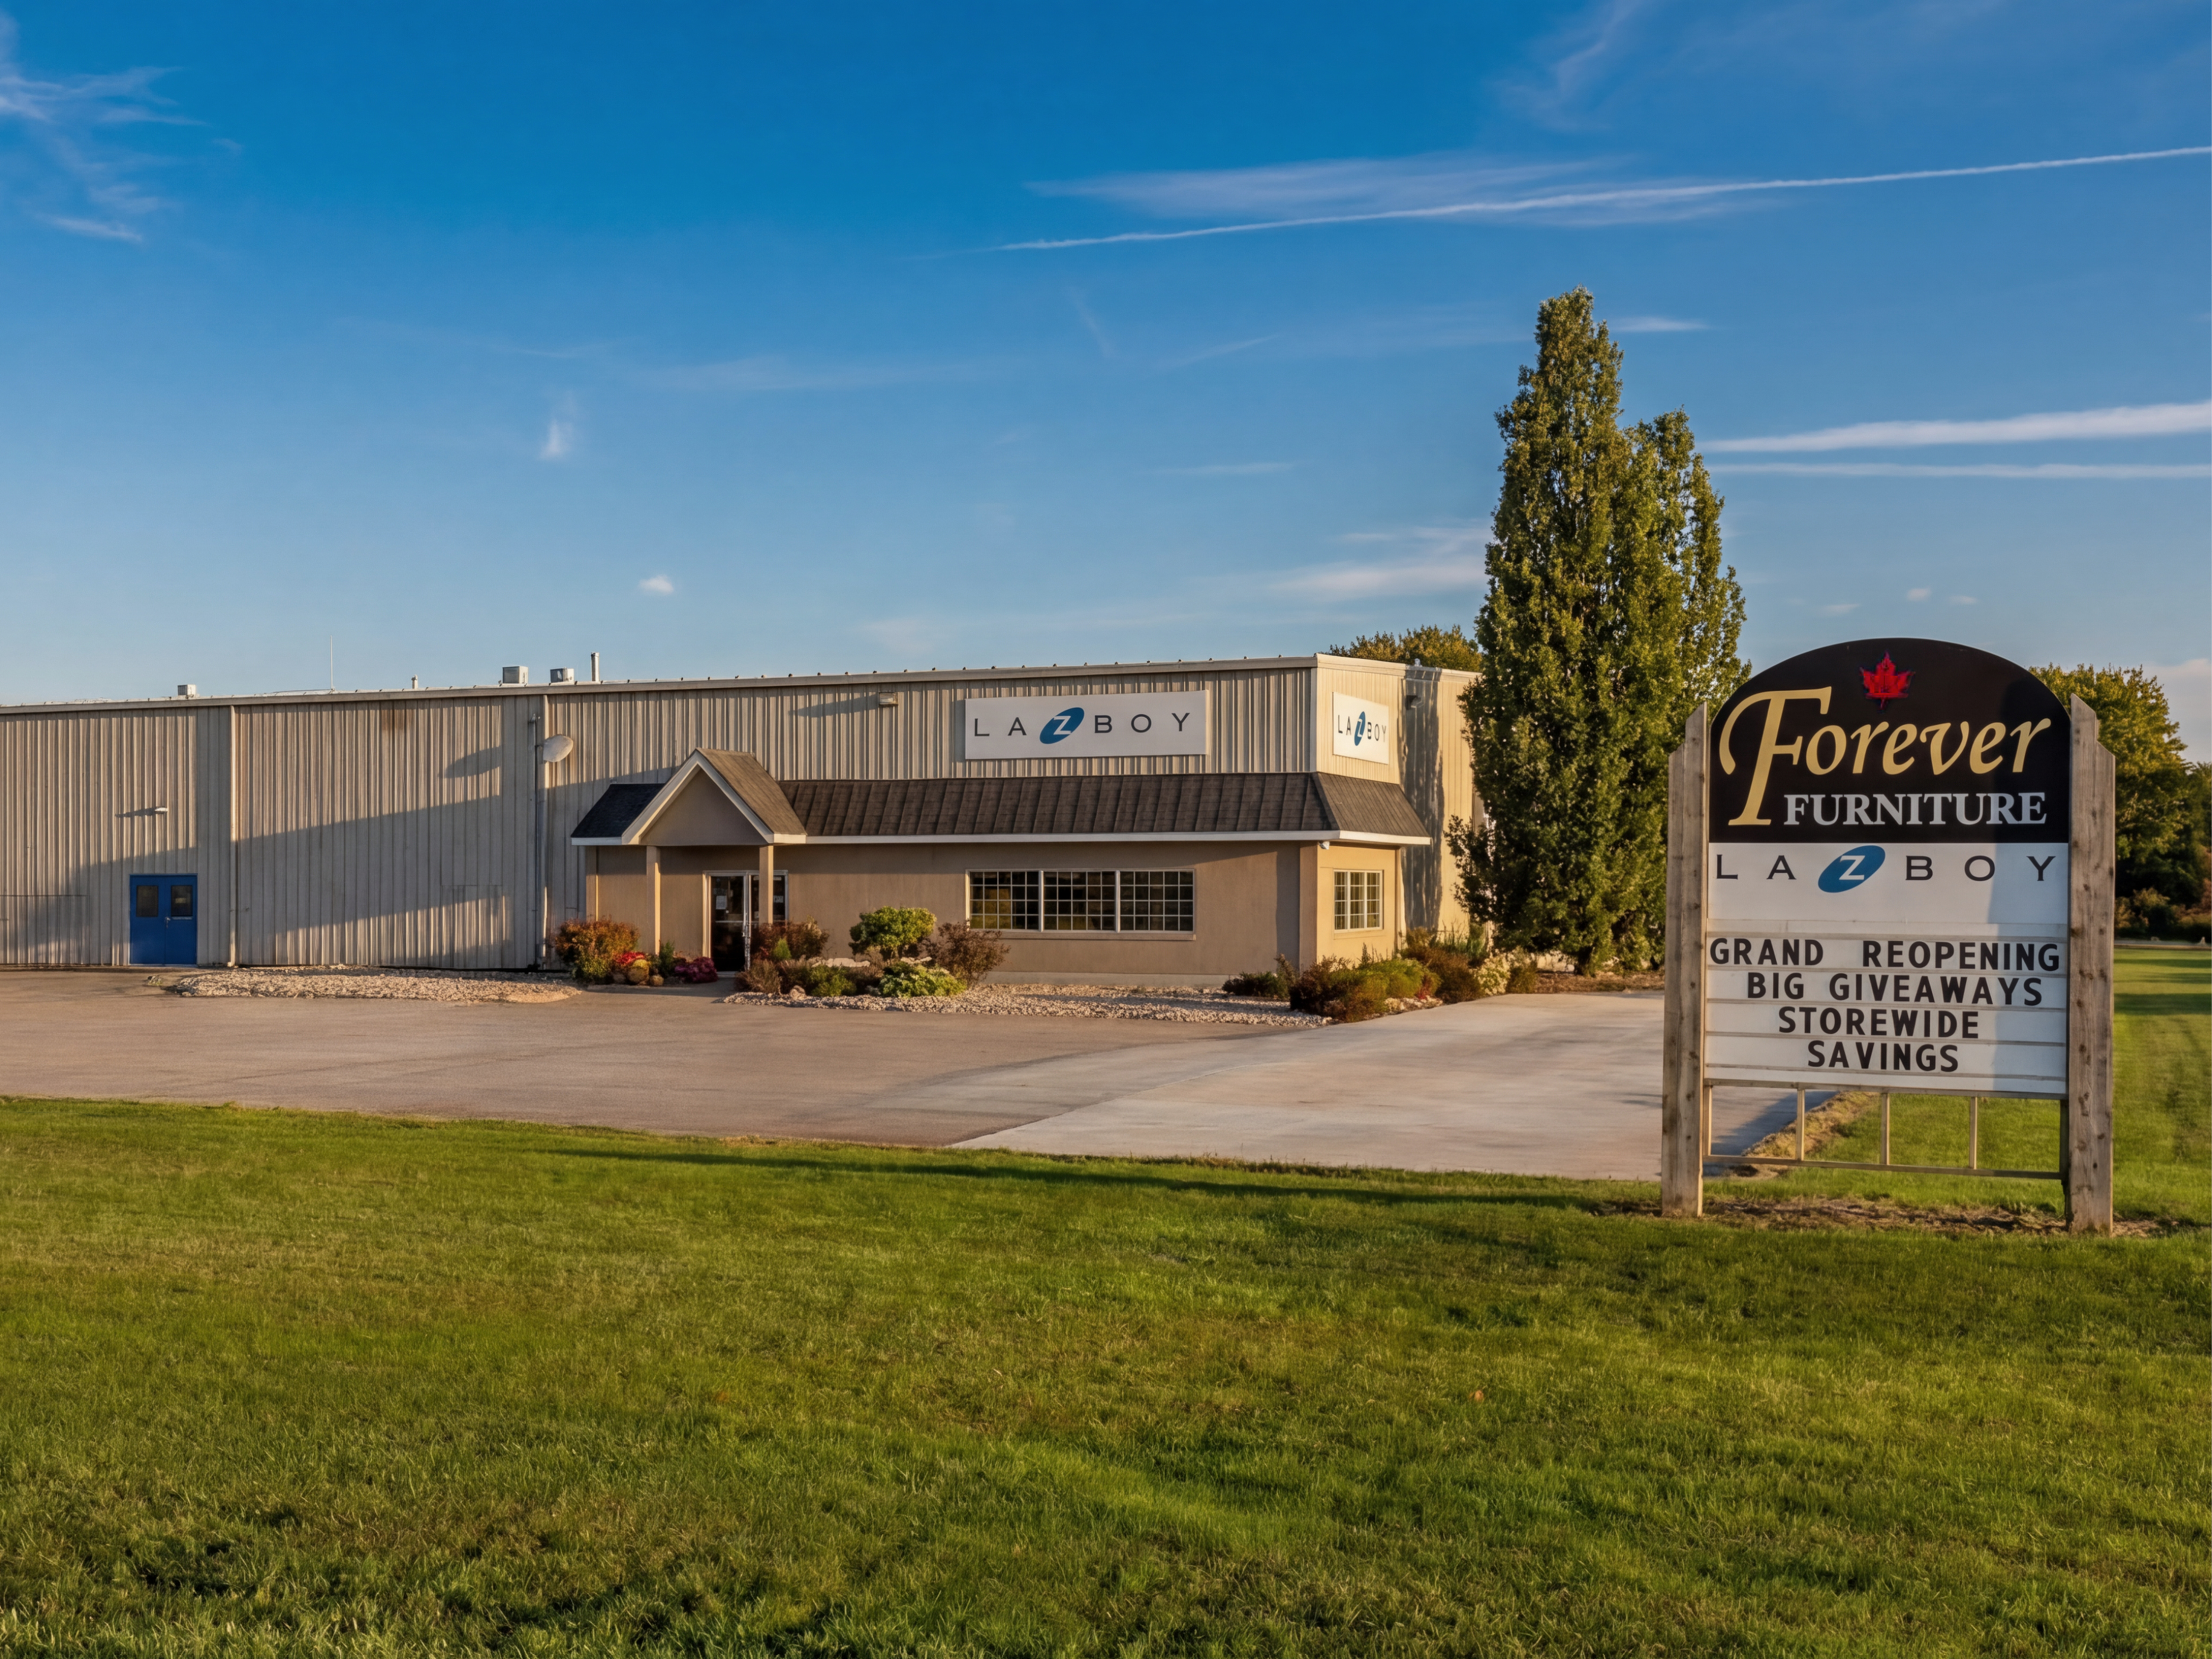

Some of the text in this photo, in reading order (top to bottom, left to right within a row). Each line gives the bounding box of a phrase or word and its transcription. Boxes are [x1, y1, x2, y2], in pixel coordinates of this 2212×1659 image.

[1719, 685, 2052, 826] Forever
[1784, 792, 2047, 826] FURNITURE
[1709, 938, 2060, 971] GRAND REOPENING
[1748, 972, 2042, 1006] BIG GIVEAWAYS
[1778, 1007, 1979, 1039] STOREWIDE
[1808, 1040, 1959, 1073] SAVINGS
